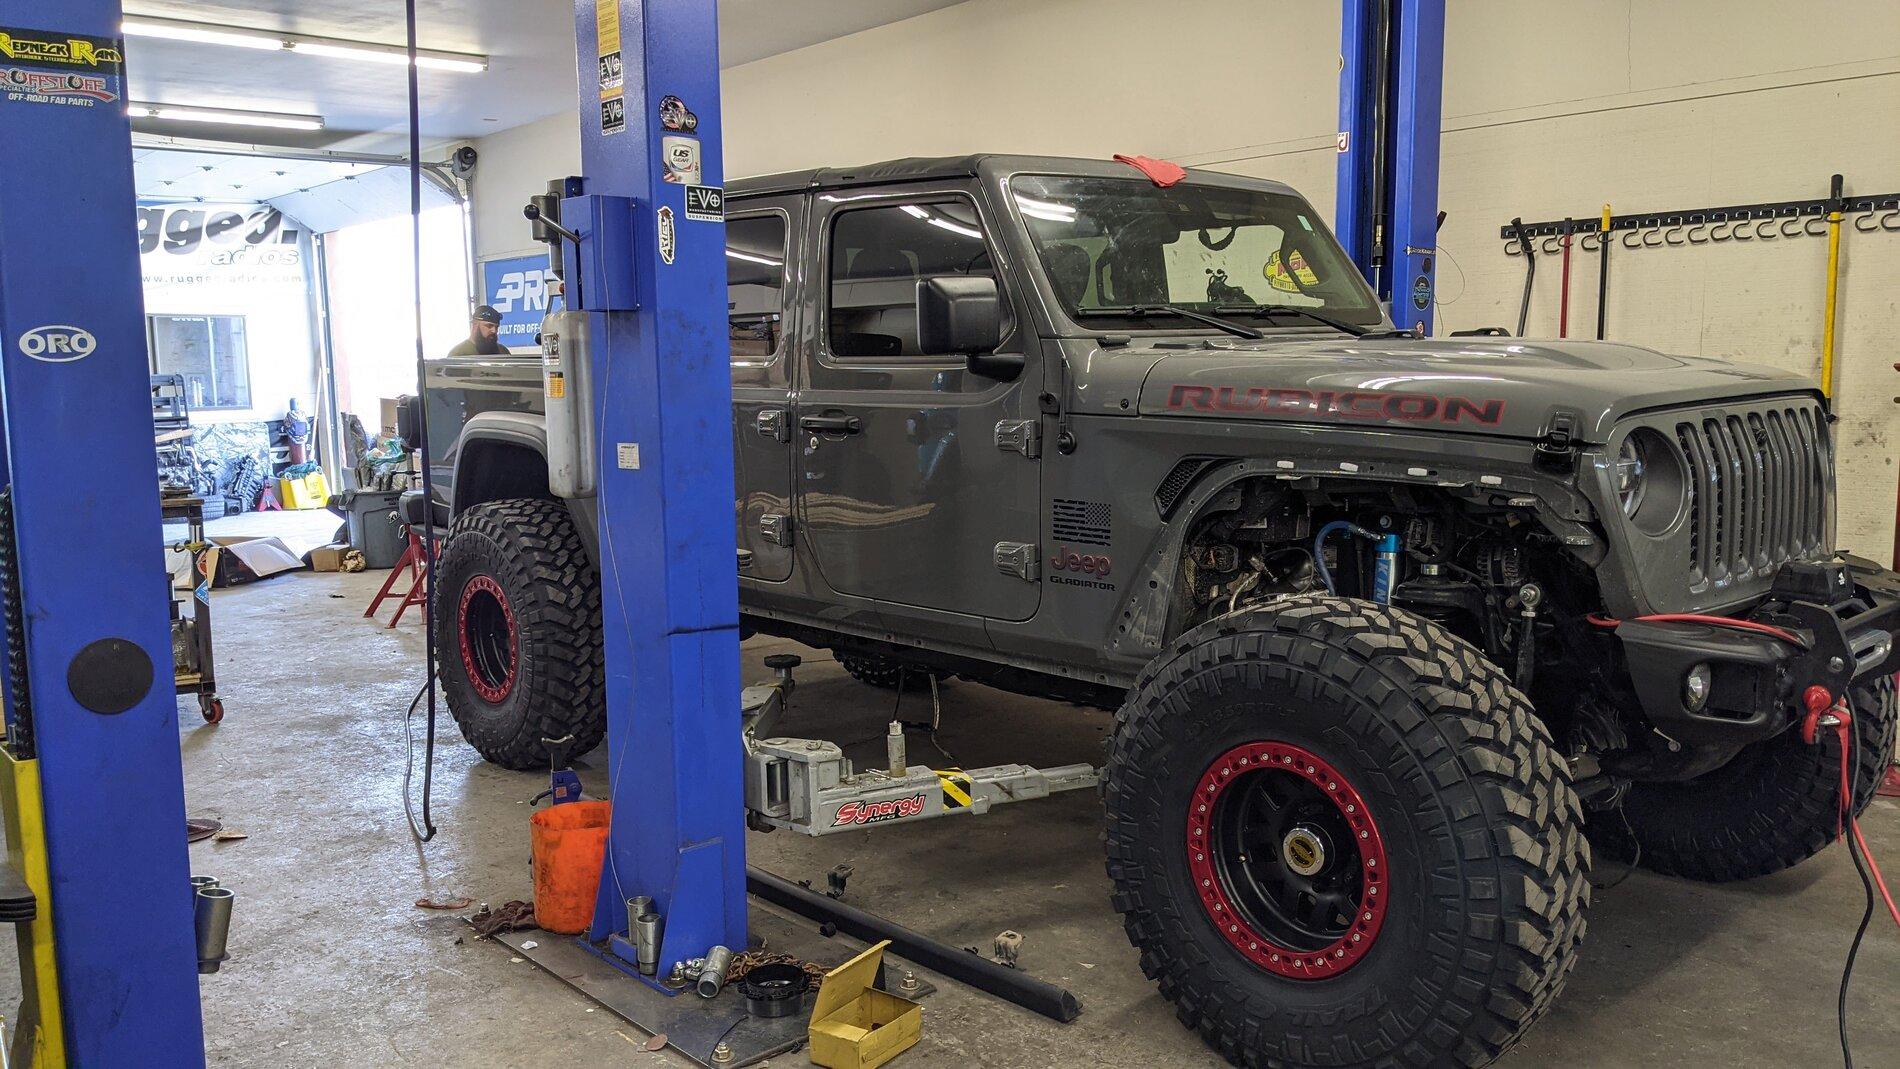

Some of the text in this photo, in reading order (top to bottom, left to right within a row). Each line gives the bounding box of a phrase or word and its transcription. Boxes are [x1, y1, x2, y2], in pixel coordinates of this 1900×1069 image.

[0, 84, 36, 93] PECIALTIES
[8, 93, 94, 107] OFF-ROAD FAB PARTS
[673, 149, 689, 157] US
[688, 189, 721, 209] EVO
[513, 324, 526, 334] FOR
[526, 323, 542, 334] OFF-
[19, 327, 97, 359] ORO
[1167, 384, 1505, 425] RUBICON
[1050, 545, 1112, 580] Jeep
[1050, 575, 1116, 591] GLADIATOR
[1376, 561, 1388, 603] KIN
[831, 793, 926, 826] Synergy
